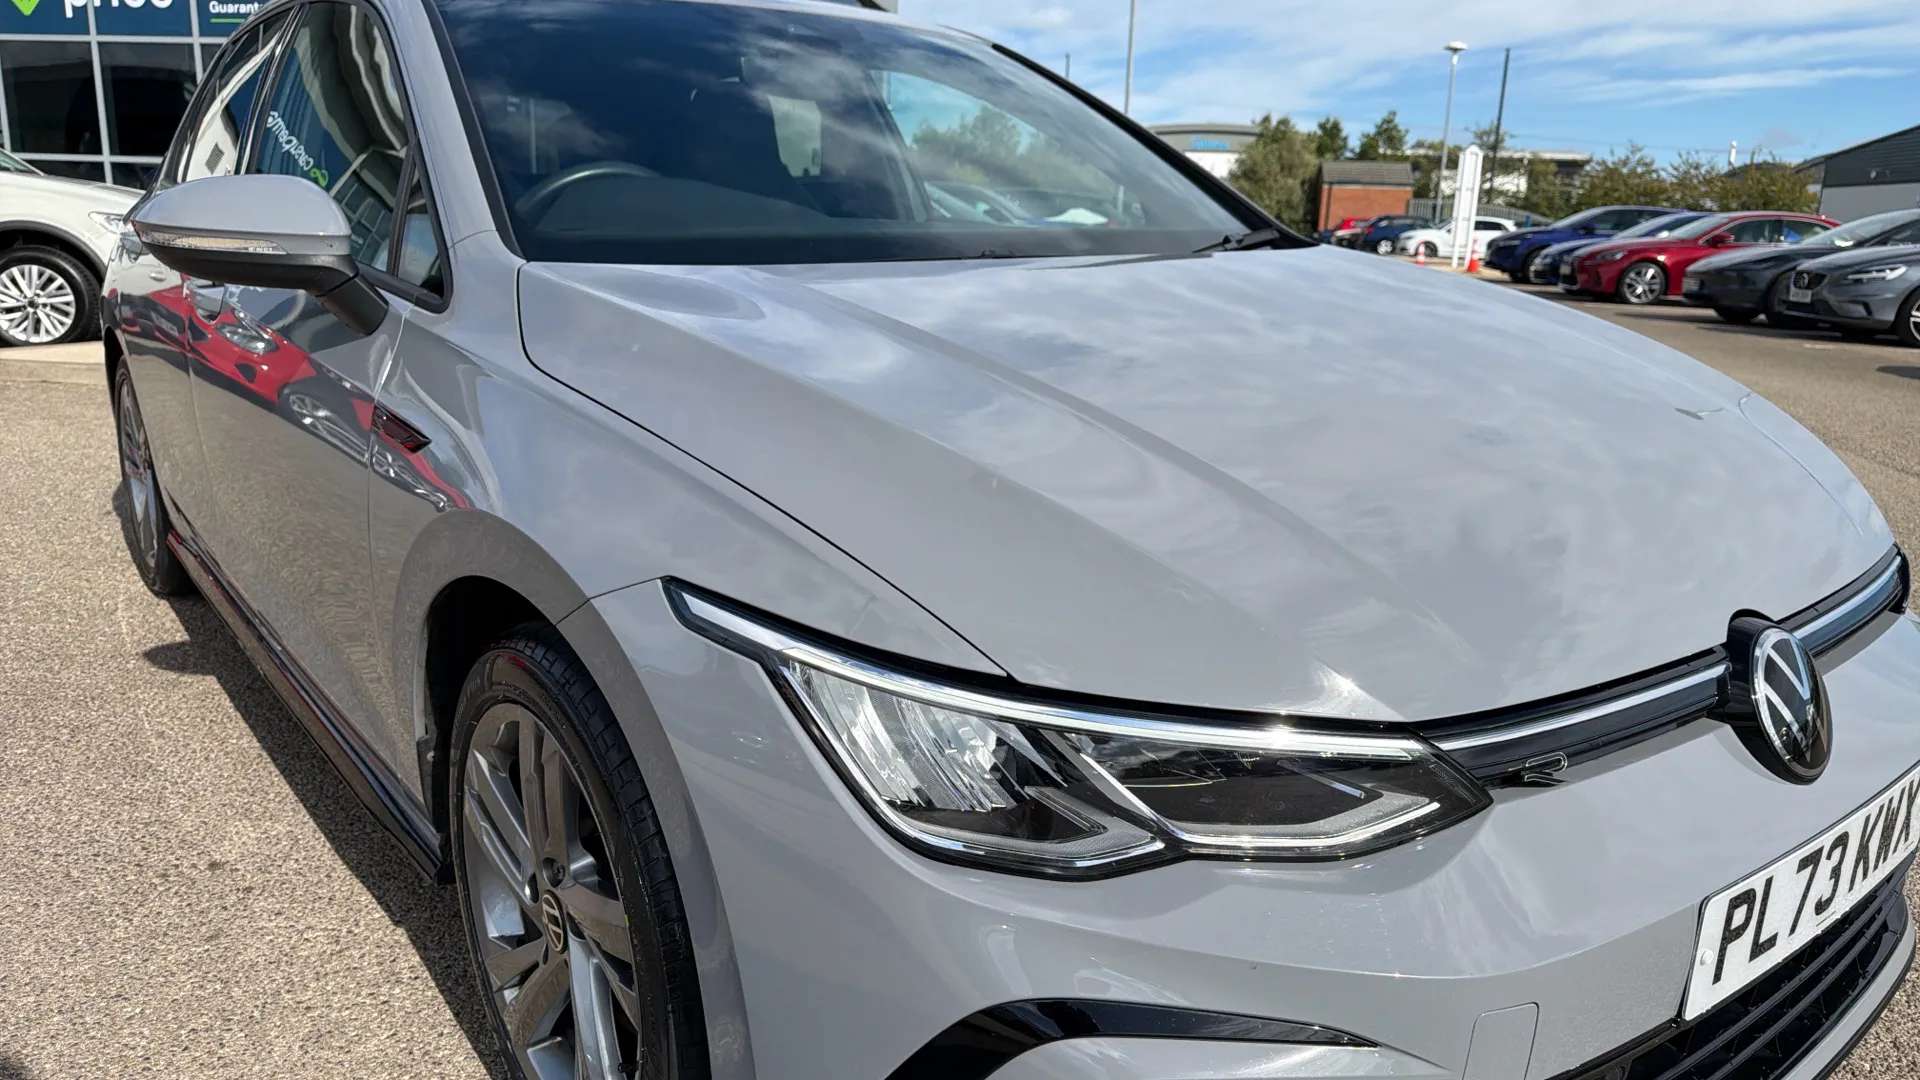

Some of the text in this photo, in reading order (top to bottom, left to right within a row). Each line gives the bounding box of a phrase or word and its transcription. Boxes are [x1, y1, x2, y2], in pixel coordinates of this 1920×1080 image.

[209, 0, 264, 13] Guarant
[1712, 777, 1920, 985] PL73 KWX
